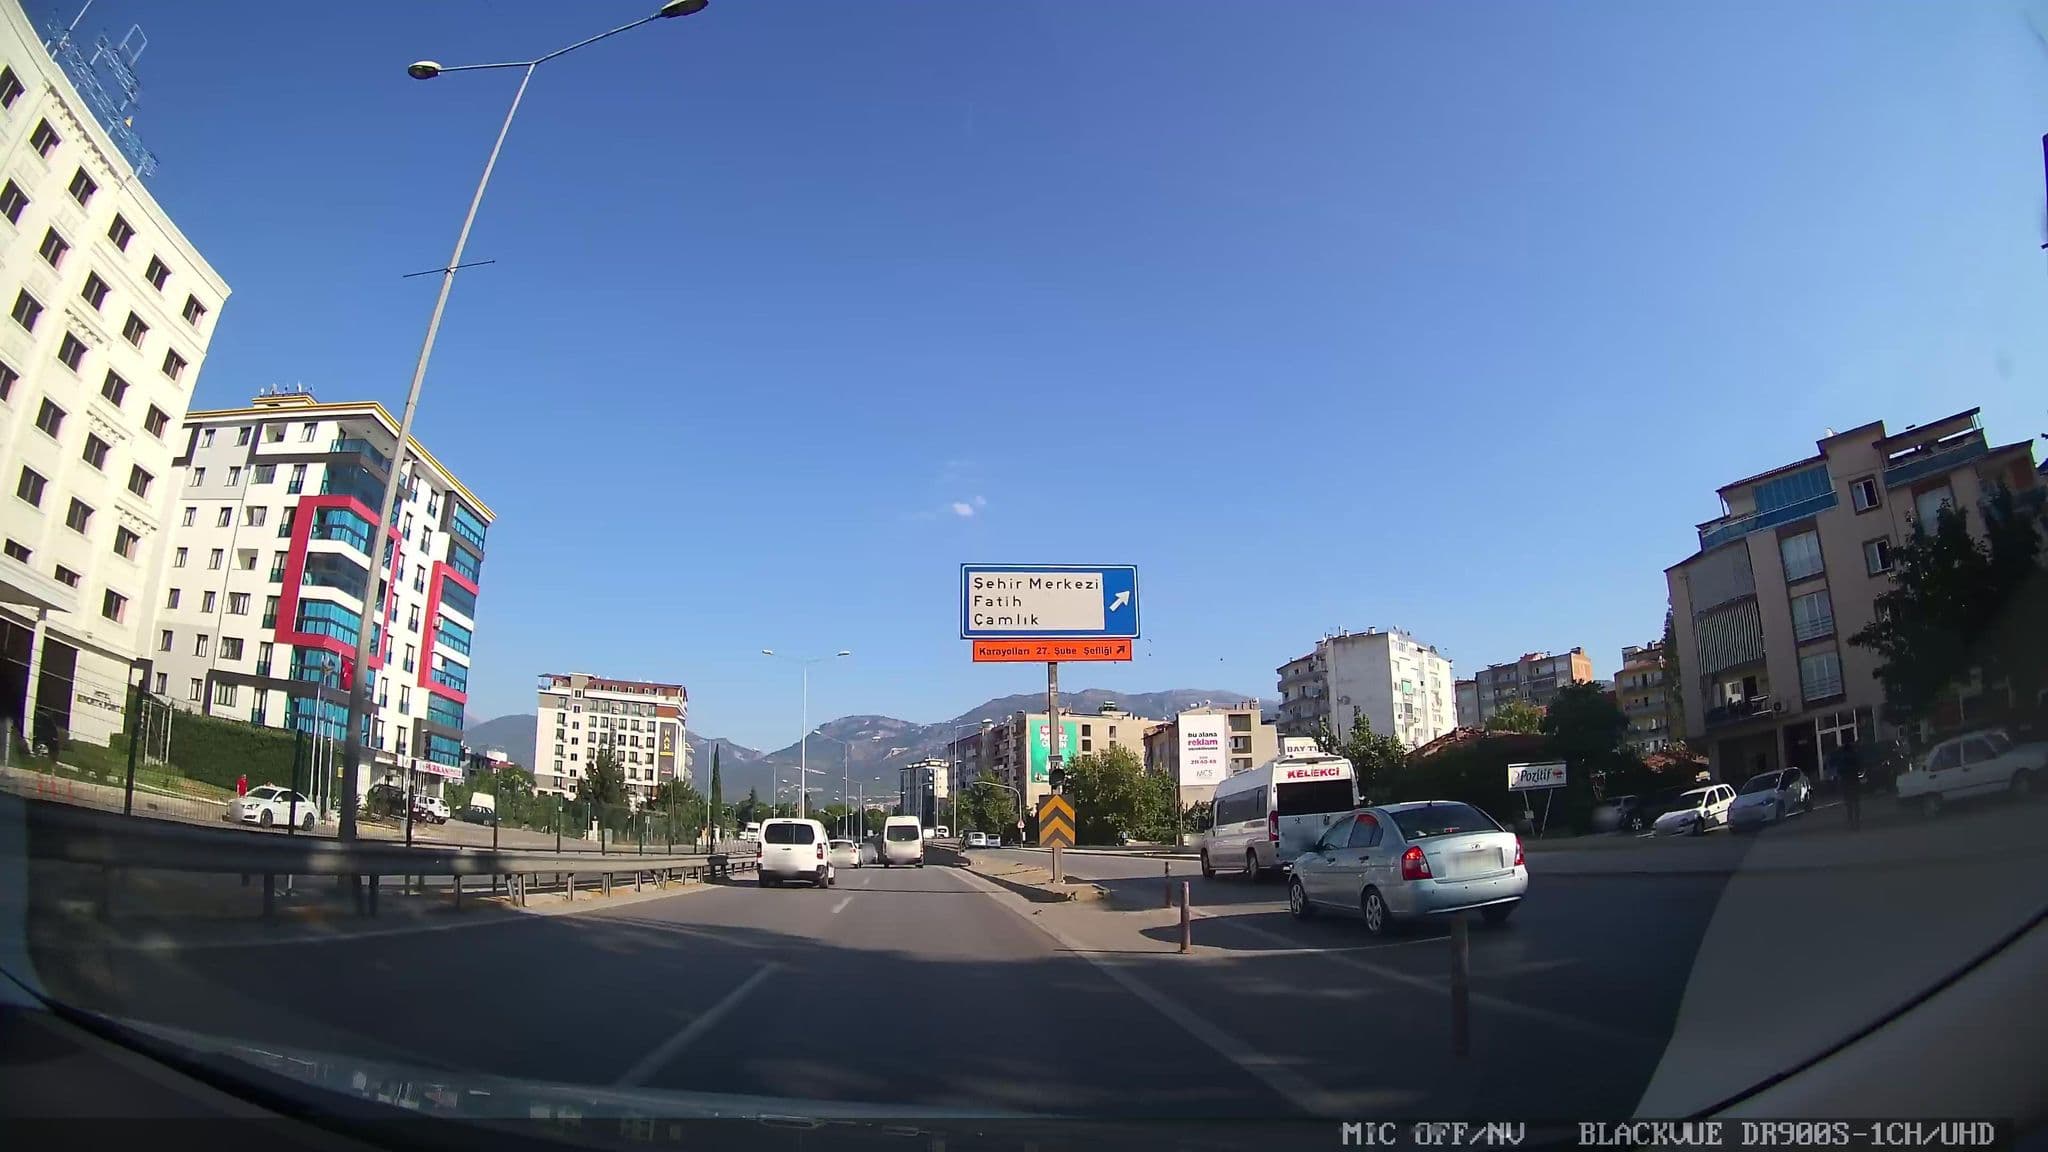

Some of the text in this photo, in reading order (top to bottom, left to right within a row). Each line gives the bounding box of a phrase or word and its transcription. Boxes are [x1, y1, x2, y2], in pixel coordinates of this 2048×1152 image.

[974, 577, 1099, 590] Şehir Merkezi
[974, 595, 1022, 607] Fatih
[974, 613, 1039, 626] Çamlık
[979, 647, 1030, 656] Karayolları
[1054, 647, 1077, 655] Şube
[1188, 738, 1218, 746] reklam
[1520, 768, 1552, 782] Pozitif
